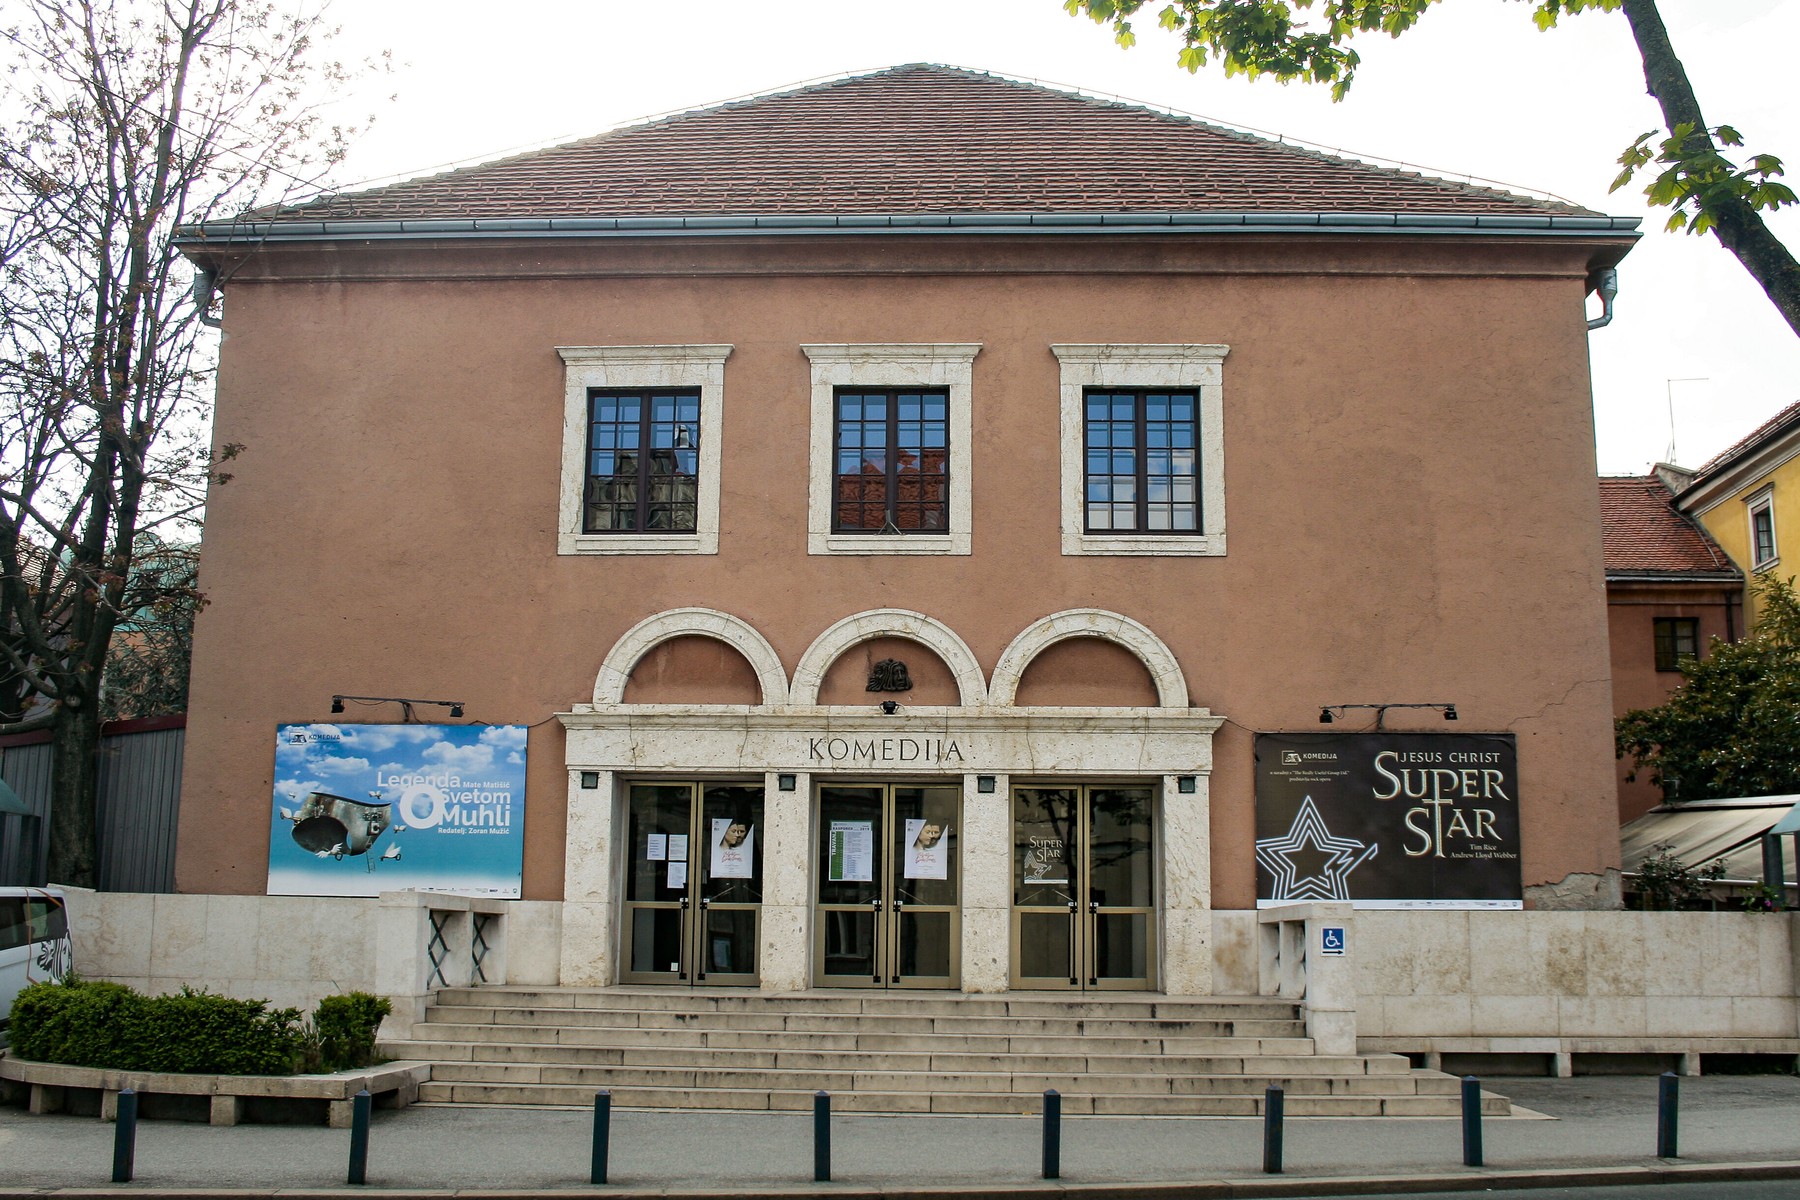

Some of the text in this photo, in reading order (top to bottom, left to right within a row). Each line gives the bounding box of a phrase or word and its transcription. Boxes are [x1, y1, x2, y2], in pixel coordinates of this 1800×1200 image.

[808, 737, 965, 765] KOMEDIJA
[1400, 751, 1501, 764] JESUS CHRIST
[377, 771, 461, 788] Legenda
[1372, 750, 1510, 801] SUPER
[439, 788, 511, 804] Svetom
[399, 784, 446, 830] O
[438, 804, 510, 827] Muhli
[438, 827, 467, 835] Redatelj:
[489, 827, 510, 835] Mužić
[1402, 798, 1503, 859] STAR
[1029, 835, 1063, 848] SUPER
[1036, 847, 1061, 862] STAR
[1475, 851, 1493, 860] Lloyd
[1493, 851, 1517, 859] Webber
